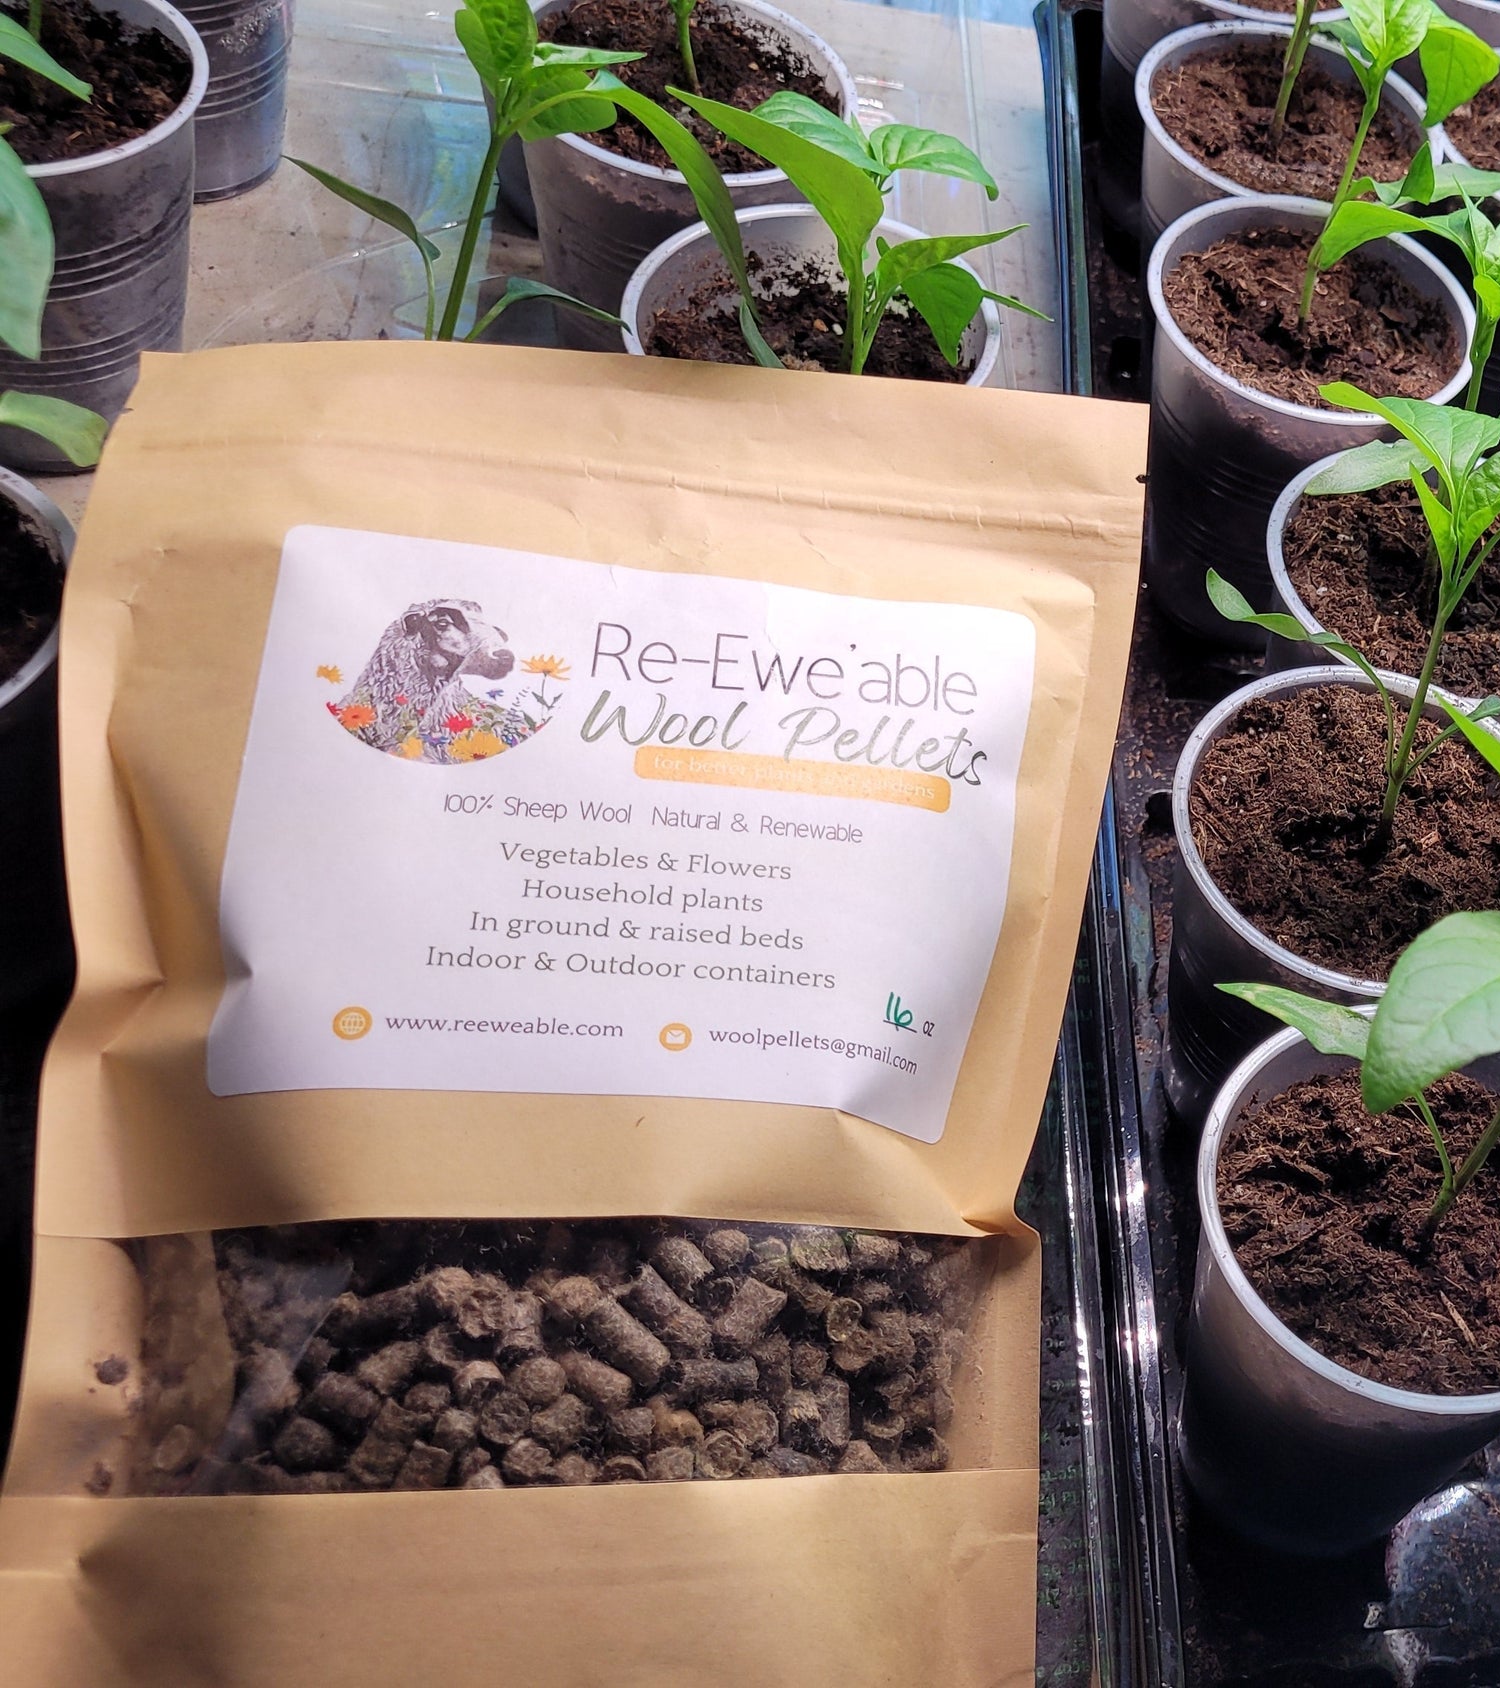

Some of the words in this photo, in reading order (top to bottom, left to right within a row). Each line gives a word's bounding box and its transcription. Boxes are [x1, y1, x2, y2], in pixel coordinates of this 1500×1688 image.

[580, 690, 749, 751] Wool
[778, 701, 988, 786] Pellets
[655, 754, 683, 770] for
[689, 759, 746, 776] better
[443, 793, 492, 814] 100%
[503, 796, 567, 824] Sheep
[580, 801, 632, 824] Wool
[652, 806, 721, 831] Natural
[730, 813, 749, 832] &
[759, 816, 863, 843] Renewable
[499, 842, 649, 870] Vegetables
[657, 852, 679, 872] &
[687, 854, 792, 880] Flowers
[522, 878, 673, 906] Household
[681, 885, 763, 913] plants
[470, 911, 498, 932] In
[507, 917, 609, 939] ground
[619, 920, 640, 939] &
[648, 924, 731, 946] raised
[739, 926, 804, 951] beds
[425, 946, 526, 970] Indoor
[534, 952, 556, 972] &
[566, 953, 686, 979] Outdoor
[693, 960, 836, 989] containers
[385, 1013, 624, 1038] www.reeweable.com
[886, 992, 913, 1027] 16
[708, 1026, 918, 1076] woolpellets@gmail.com
